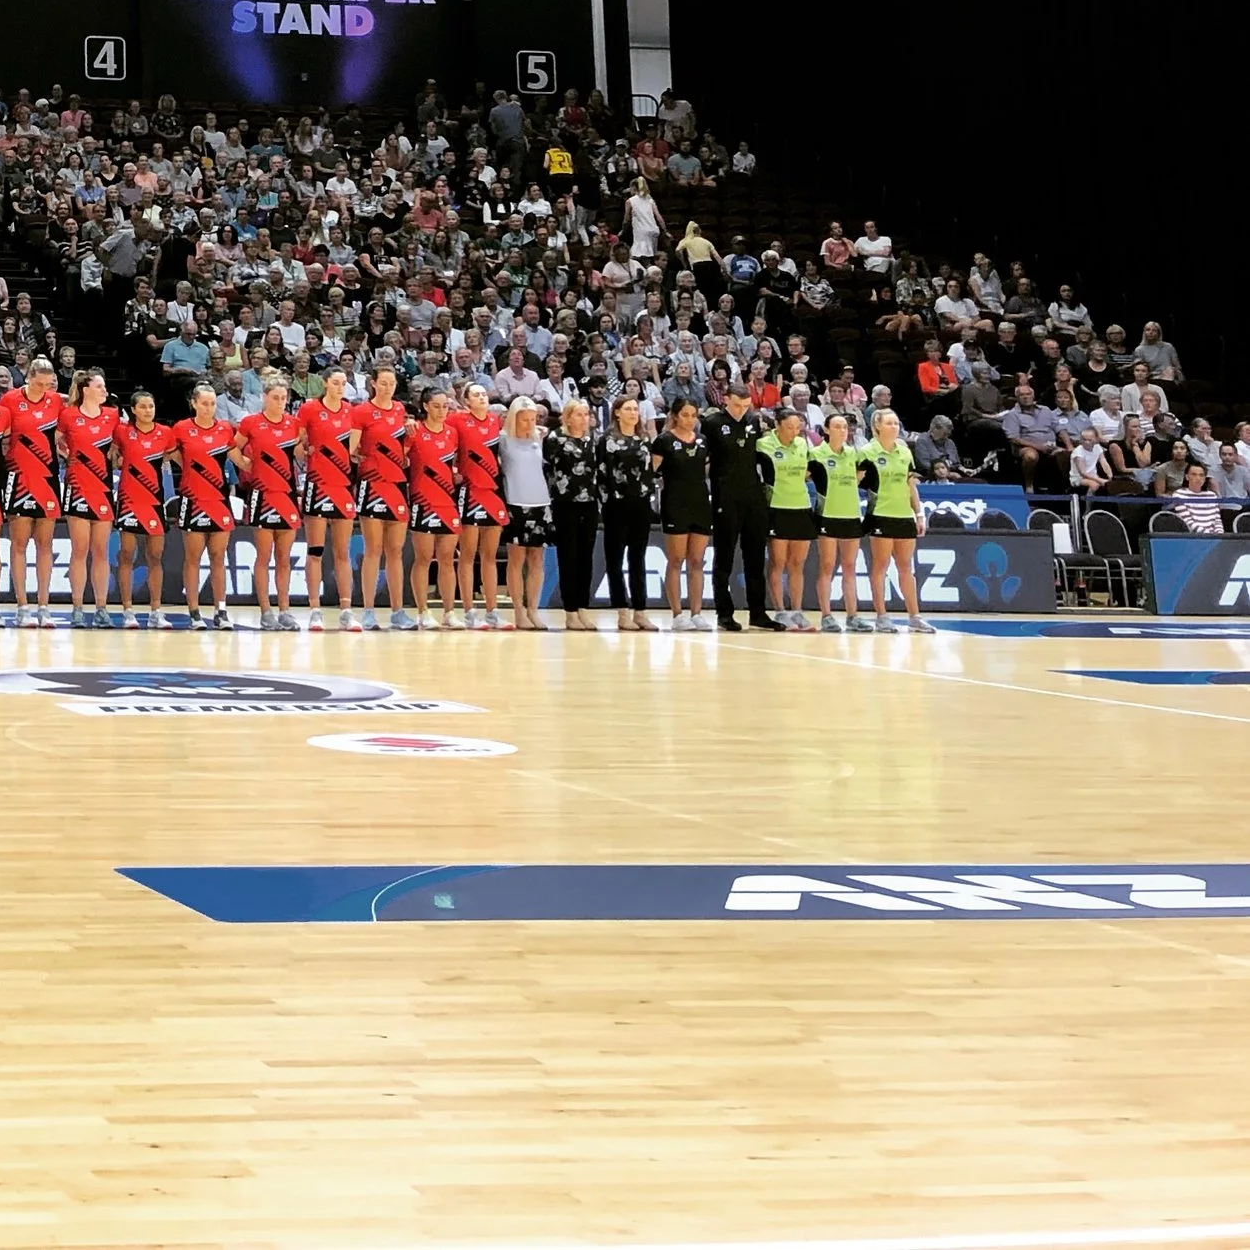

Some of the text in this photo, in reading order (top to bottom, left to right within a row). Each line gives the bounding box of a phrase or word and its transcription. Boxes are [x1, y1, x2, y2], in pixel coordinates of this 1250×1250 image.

[231, 1, 375, 37] STAND
[93, 41, 118, 76] 4
[526, 55, 549, 90] 5
[99, 703, 440, 713] PREMIERSHIP
[105, 686, 294, 696] ANZ
